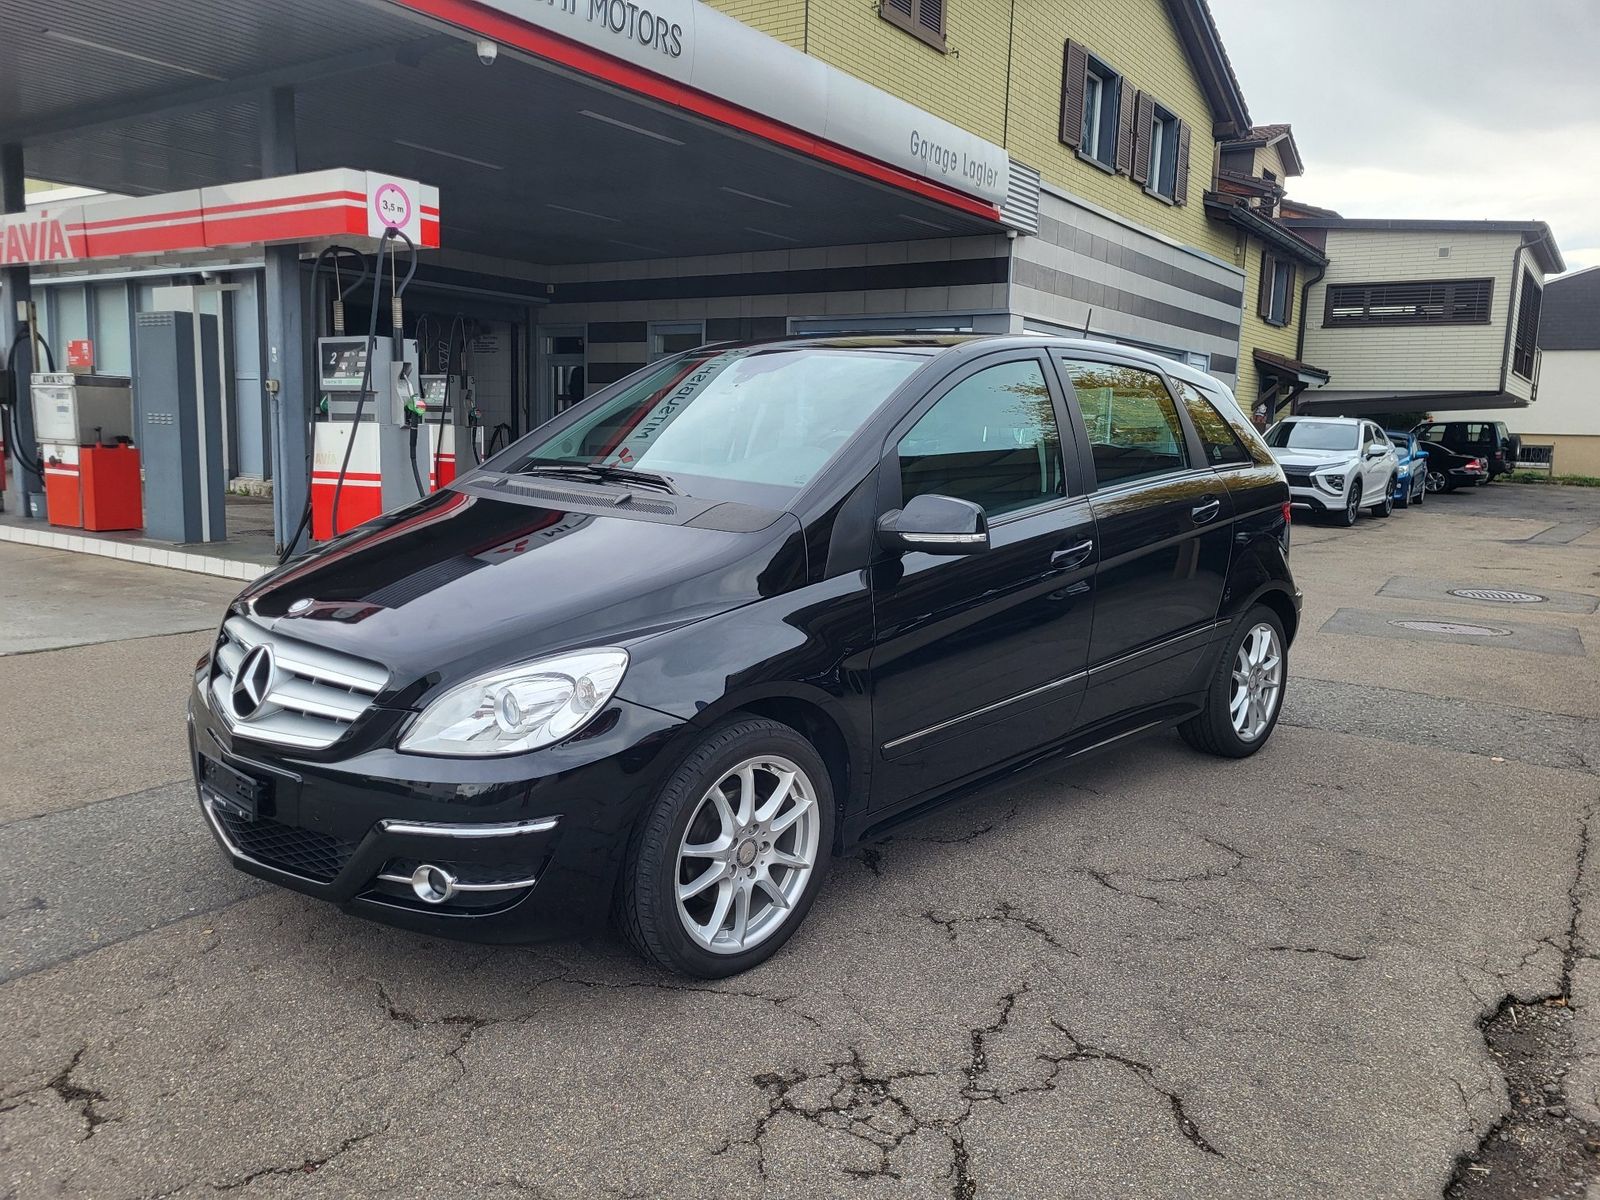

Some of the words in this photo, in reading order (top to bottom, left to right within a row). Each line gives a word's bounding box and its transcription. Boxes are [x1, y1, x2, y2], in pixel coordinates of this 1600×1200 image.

[586, 0, 682, 58] MOTORS
[910, 129, 957, 174] Garage
[963, 152, 999, 188] Lagler
[382, 199, 396, 213] 3,5
[412, 340, 418, 354] 1
[329, 351, 338, 365] 2
[449, 375, 455, 384] 3
